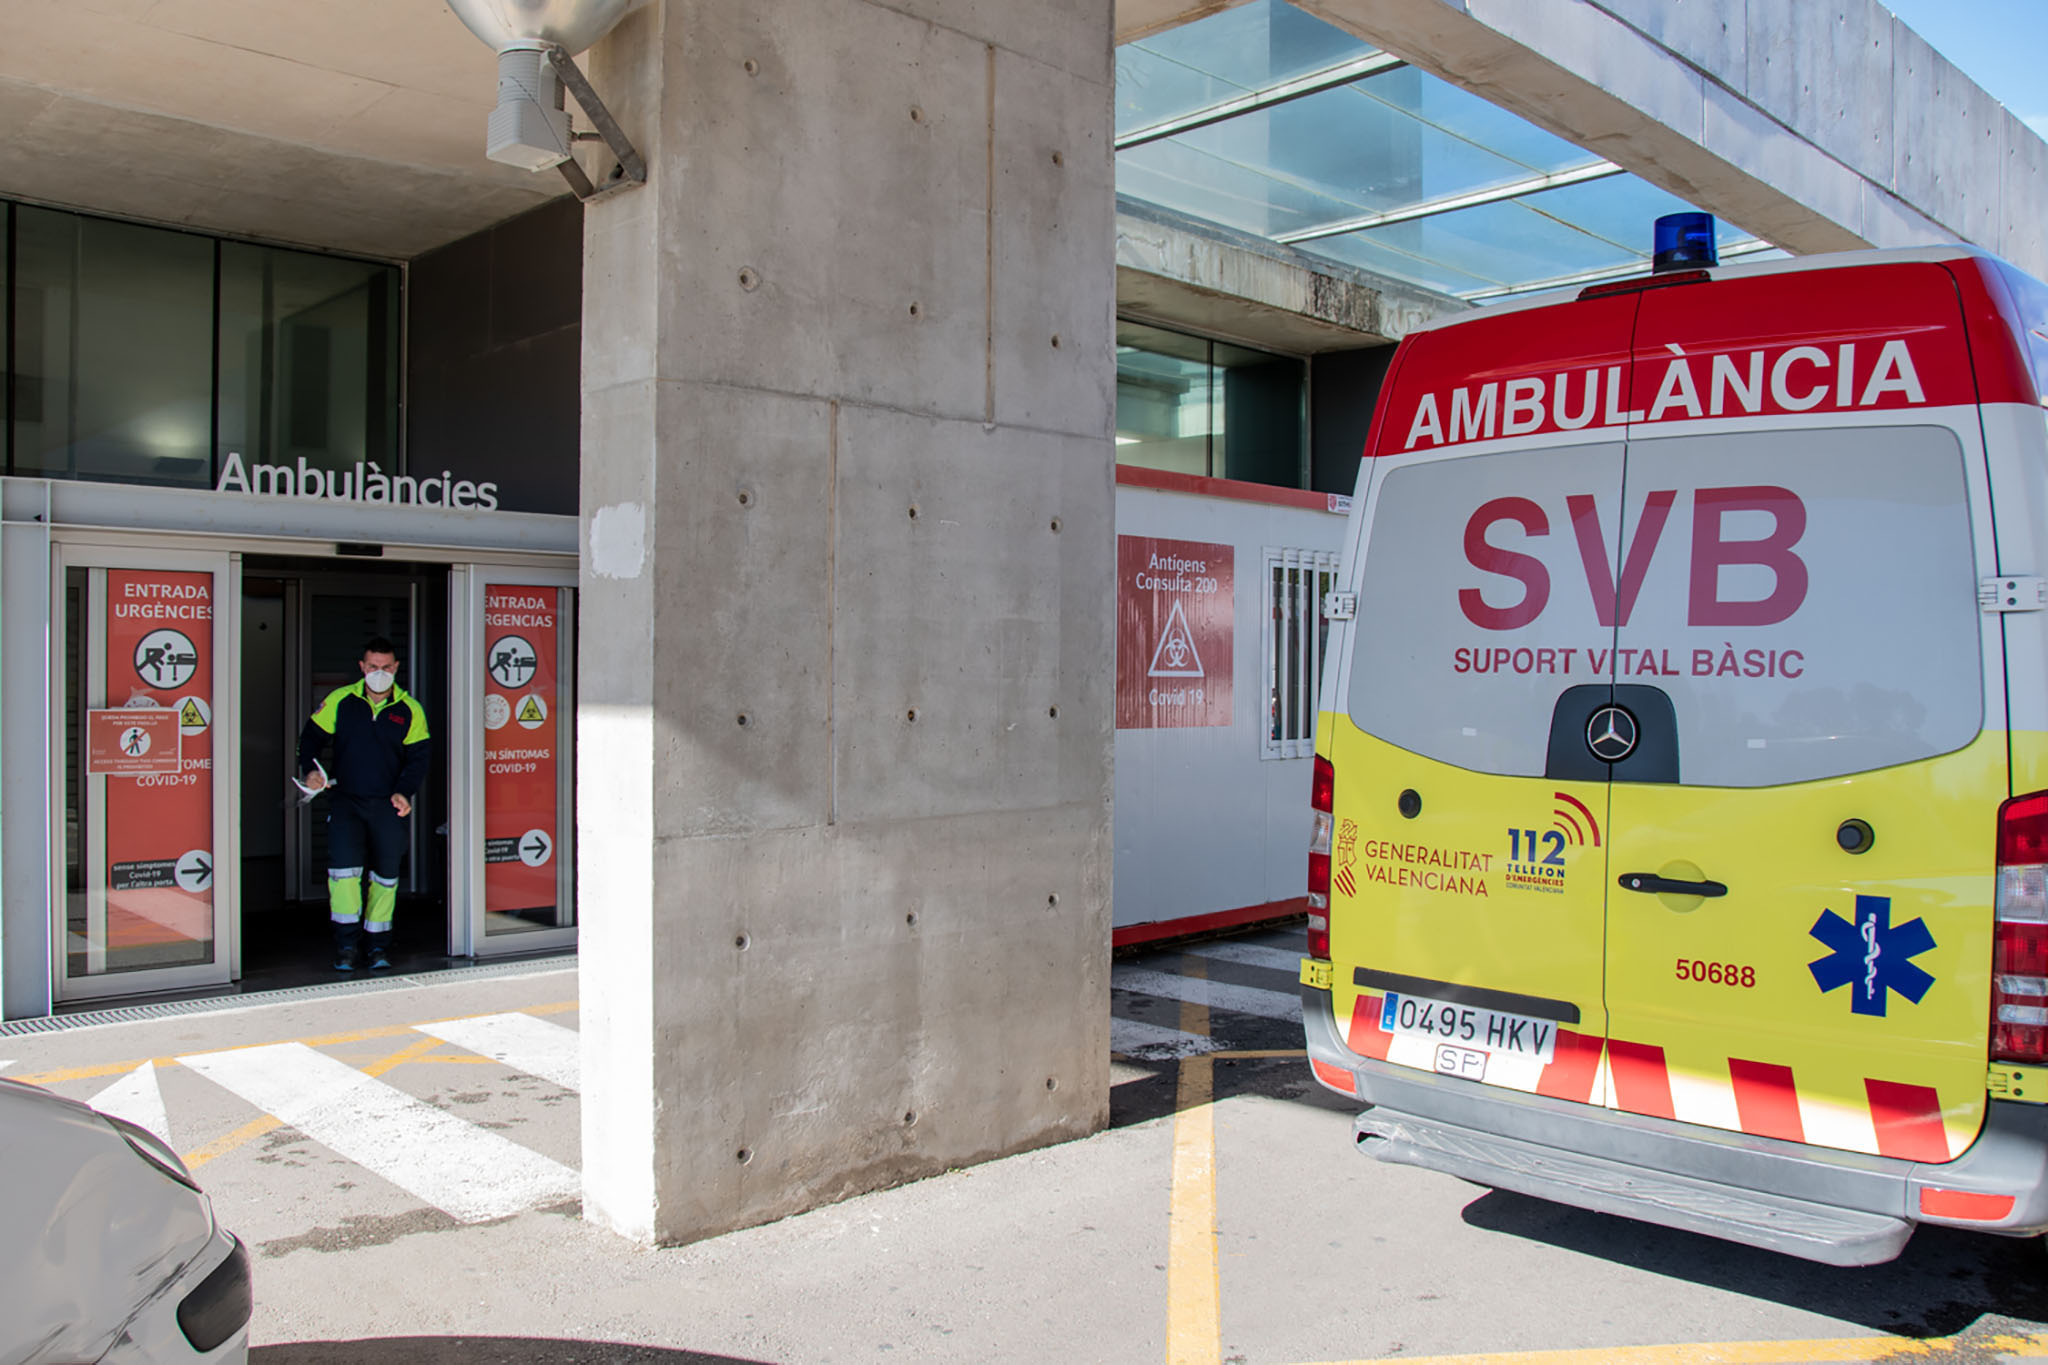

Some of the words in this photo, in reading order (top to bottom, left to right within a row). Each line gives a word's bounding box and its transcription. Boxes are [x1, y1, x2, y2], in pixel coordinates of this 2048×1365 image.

[1404, 340, 1927, 450] AMBULÀNCIA
[216, 452, 498, 511] Ambulàncies
[1149, 553, 1206, 576] Antígens
[1458, 485, 1809, 631] SVB
[124, 583, 209, 600] ENTRADA
[1136, 572, 1192, 592] Consulta
[1195, 577, 1218, 593] 200
[485, 613, 553, 628] RGENCIAS
[1454, 648, 1577, 675] SUPORT
[1587, 648, 1680, 676] VITAL
[1691, 642, 1805, 679] BÀSIC
[1149, 688, 1185, 706] Covid
[1188, 688, 1204, 705] 19
[489, 762, 537, 774] COVID-19
[498, 748, 551, 761] SÍNTOMAS
[136, 774, 197, 787] COVID-19
[1365, 840, 1494, 872] GENERALITAT
[1507, 828, 1566, 866] 112
[1365, 863, 1489, 897] VALENCIANA
[1675, 958, 1756, 988] 50688
[1385, 1015, 1392, 1025] E
[1400, 1000, 1476, 1041] 0495
[1486, 1014, 1549, 1056] HKV
